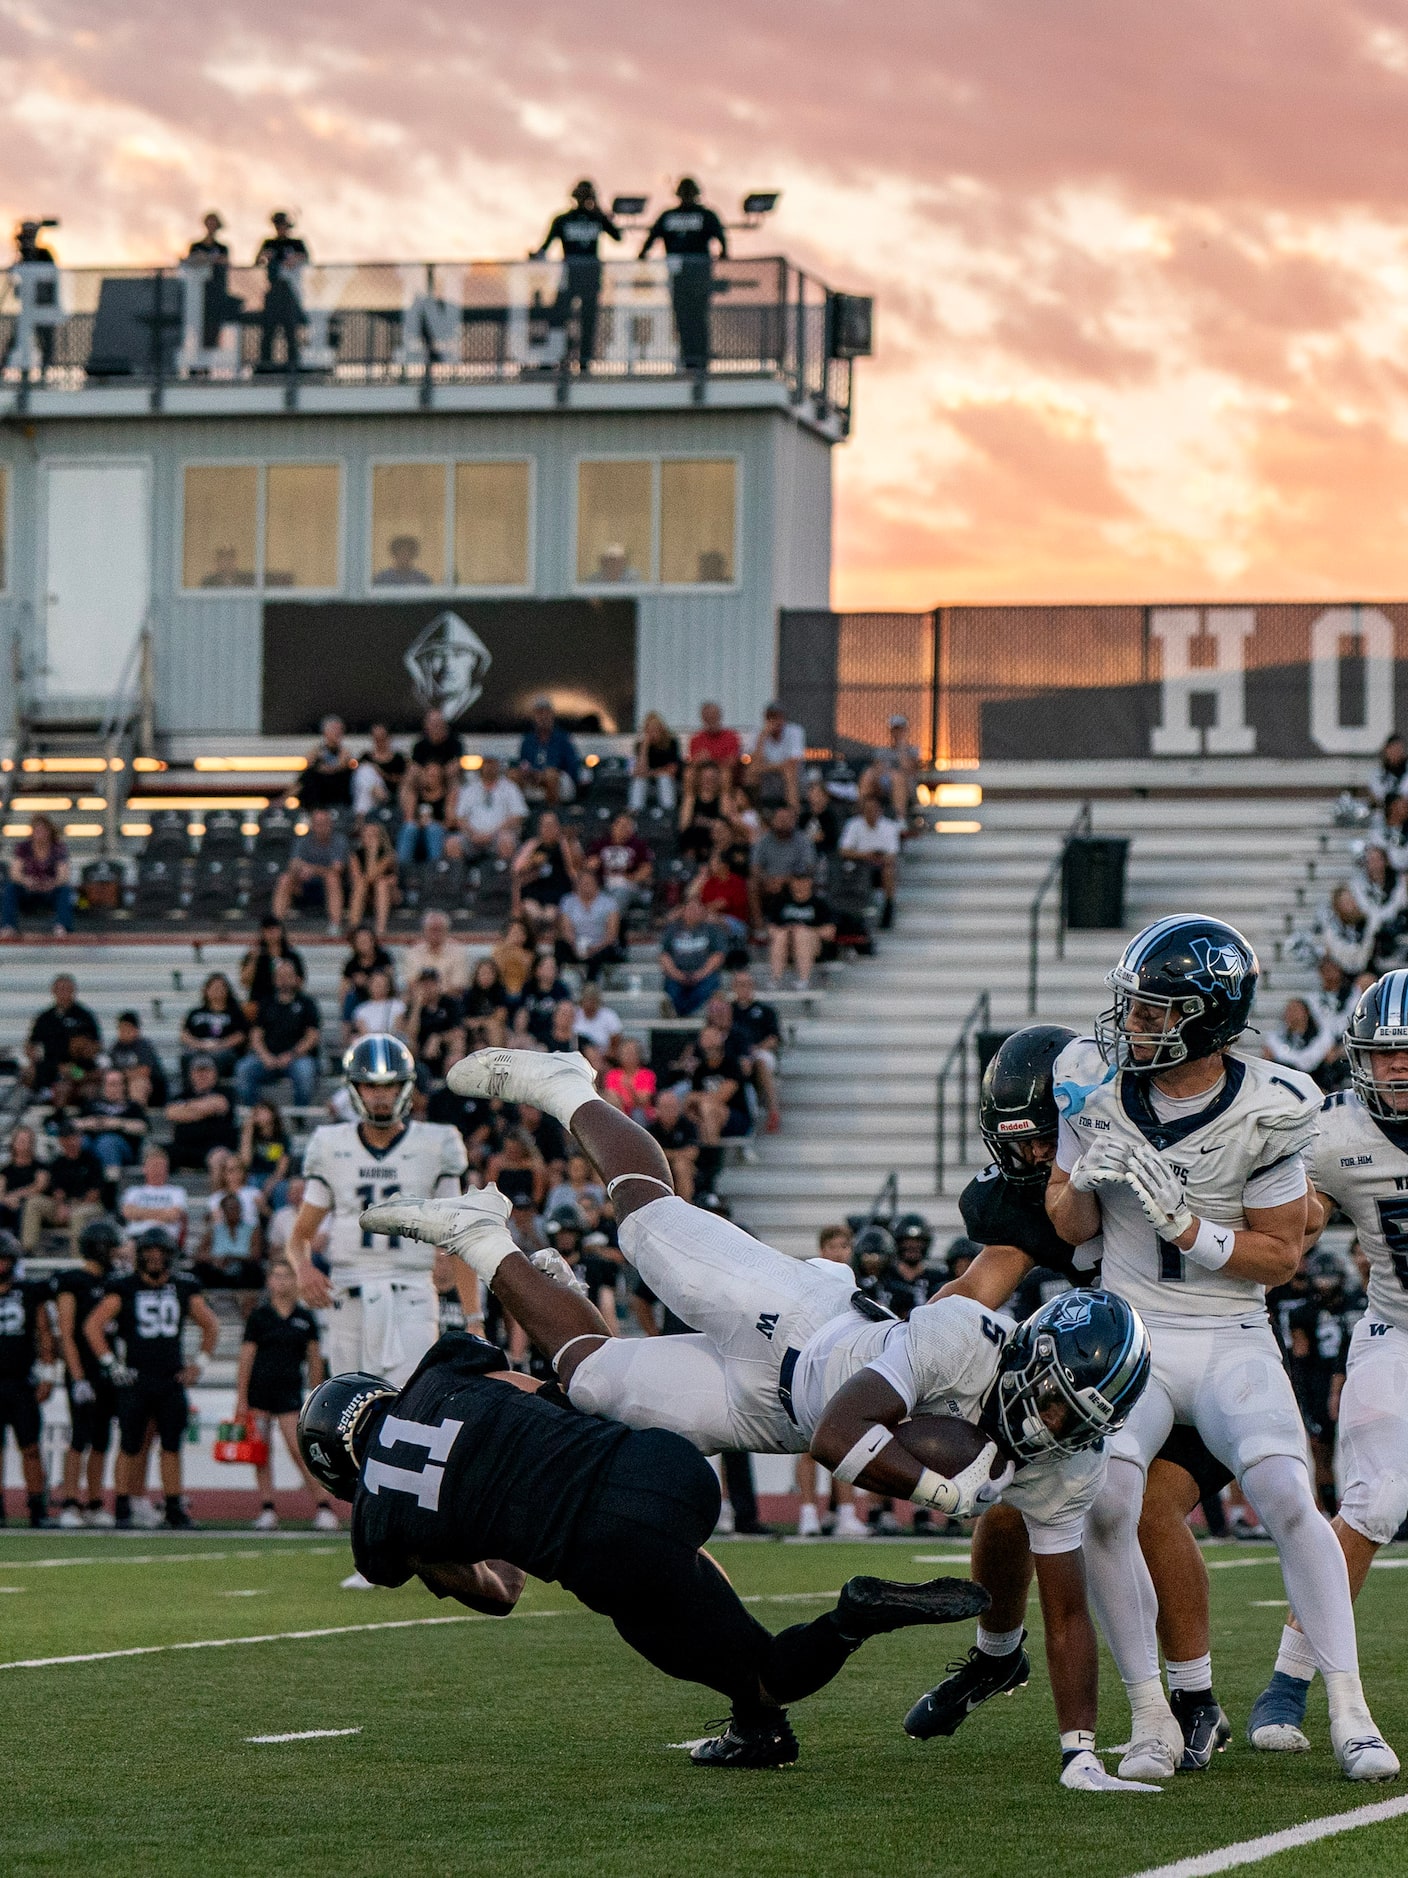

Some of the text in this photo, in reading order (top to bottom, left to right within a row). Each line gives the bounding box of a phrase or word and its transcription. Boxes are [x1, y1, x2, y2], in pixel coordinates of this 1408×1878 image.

[1380, 1027, 1408, 1036] BE-ONE
[1000, 1120, 1029, 1132] Riddell
[1079, 1117, 1111, 1131] FOR HIM
[1341, 1155, 1373, 1168] FOR HIM
[359, 1167, 398, 1181] WARRIORS
[135, 1296, 180, 1338] 50
[755, 1312, 780, 1343] W
[1369, 1323, 1394, 1337] W
[1087, 1392, 1112, 1416] BE-ONE
[338, 1392, 365, 1432] schutt
[364, 1414, 464, 1512] 11
